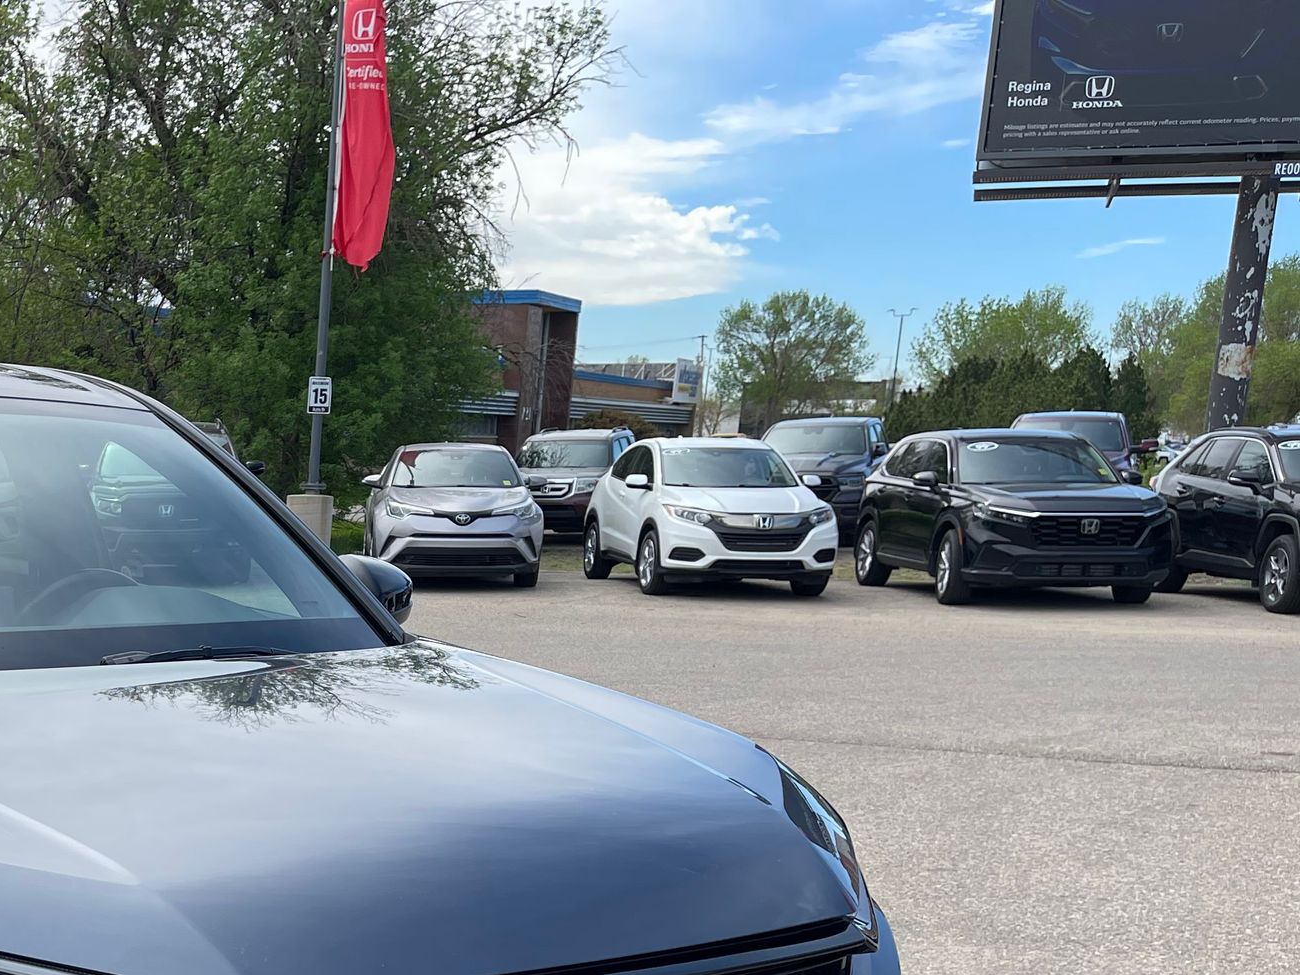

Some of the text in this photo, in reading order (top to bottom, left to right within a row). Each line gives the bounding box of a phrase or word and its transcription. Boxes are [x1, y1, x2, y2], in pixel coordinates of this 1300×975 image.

[345, 43, 375, 52] HON
[347, 65, 383, 80] ertifie
[1008, 80, 1051, 93] Regina
[1007, 95, 1048, 107] Honda
[1072, 100, 1123, 109] HONDA
[1126, 119, 1158, 128] accurately
[312, 388, 328, 405] 15
